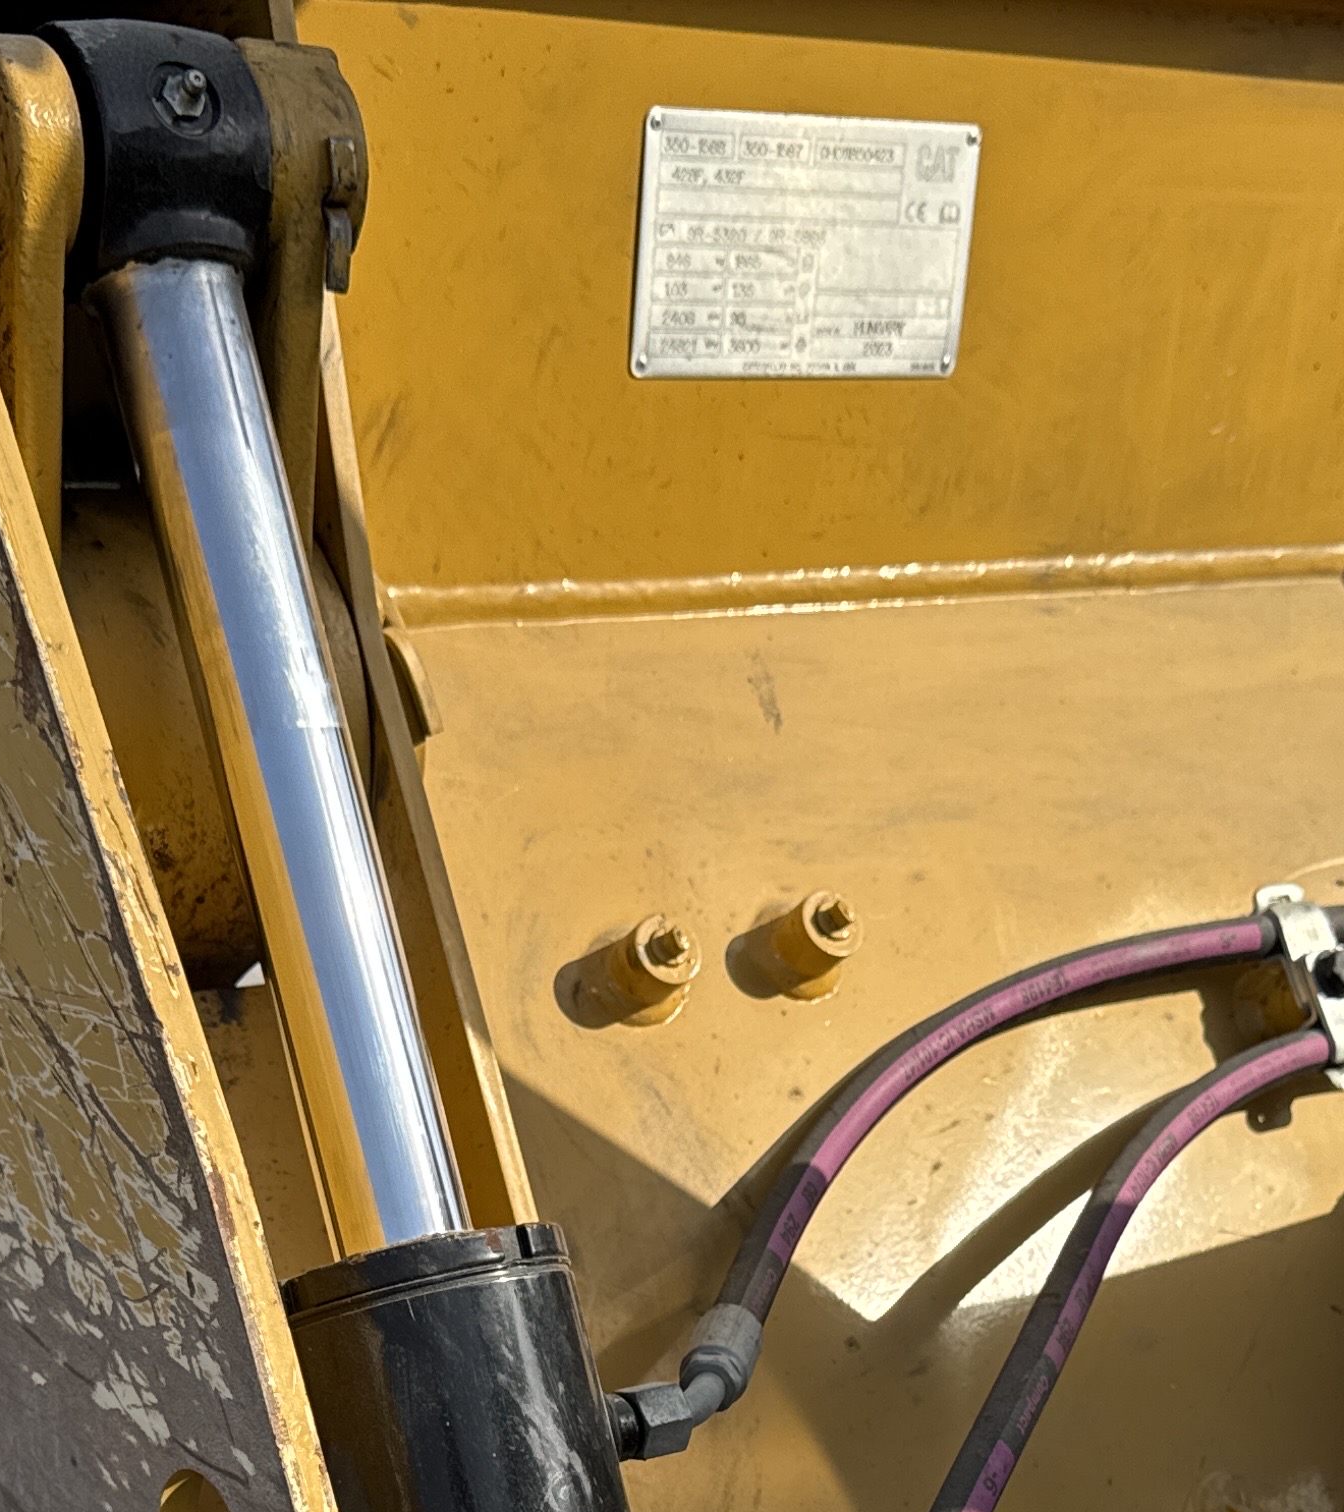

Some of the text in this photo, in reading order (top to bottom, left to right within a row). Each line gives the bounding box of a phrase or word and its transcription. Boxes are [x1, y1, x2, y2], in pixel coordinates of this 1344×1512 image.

[915, 143, 959, 183] CAT
[1020, 967, 1072, 1005] 1E4198
[1017, 1375, 1049, 1435] Compact
